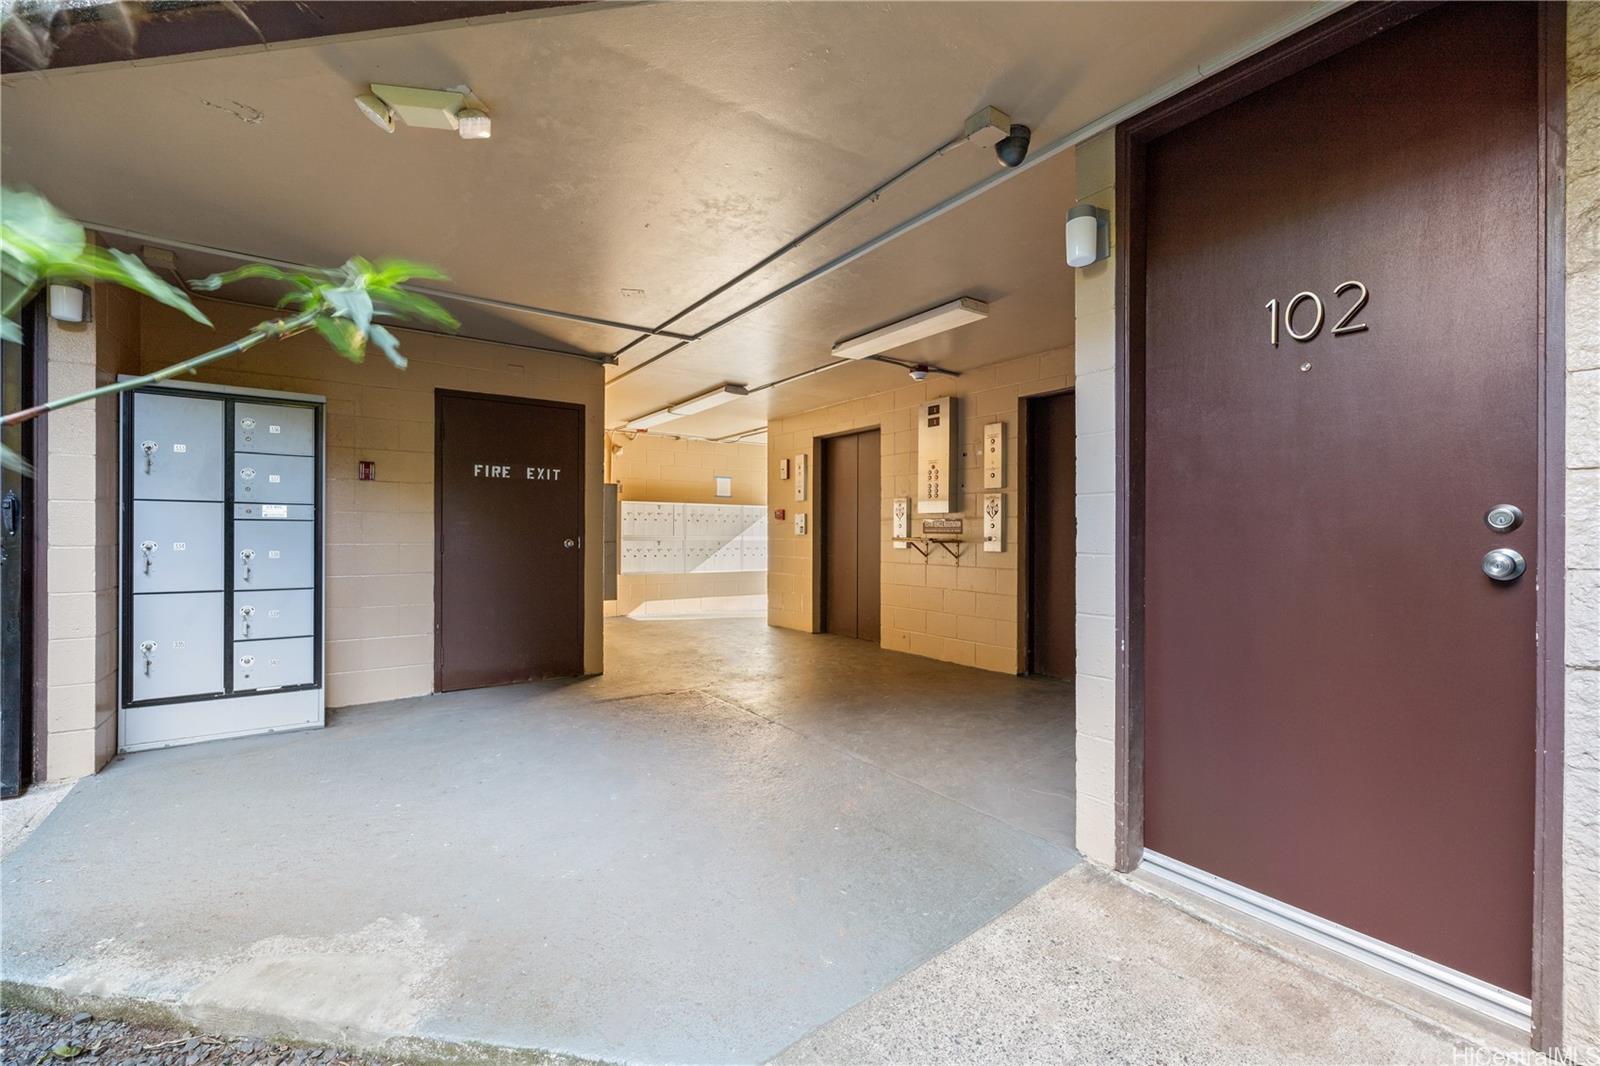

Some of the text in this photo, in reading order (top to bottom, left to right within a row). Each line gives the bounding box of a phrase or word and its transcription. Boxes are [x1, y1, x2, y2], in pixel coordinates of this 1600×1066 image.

[1265, 280, 1367, 345] 102
[474, 464, 561, 480] FIRE EXIT
